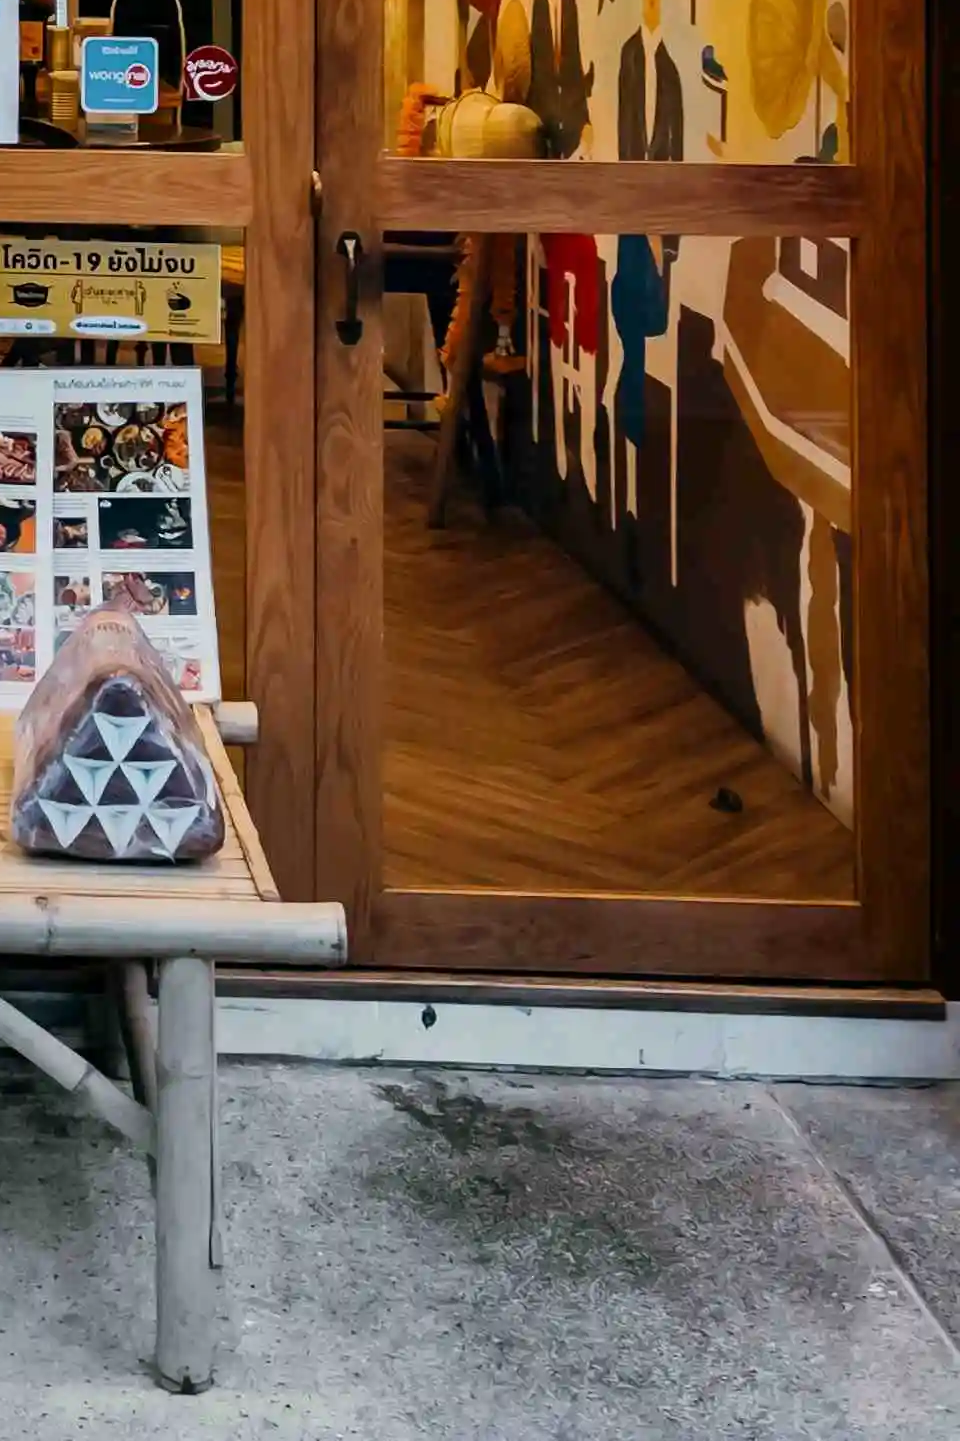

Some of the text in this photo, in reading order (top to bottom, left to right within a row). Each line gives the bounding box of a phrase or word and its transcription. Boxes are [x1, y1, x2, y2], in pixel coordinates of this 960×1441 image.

[2, 244, 195, 273] โควิด-19 ยังไม่จบ
